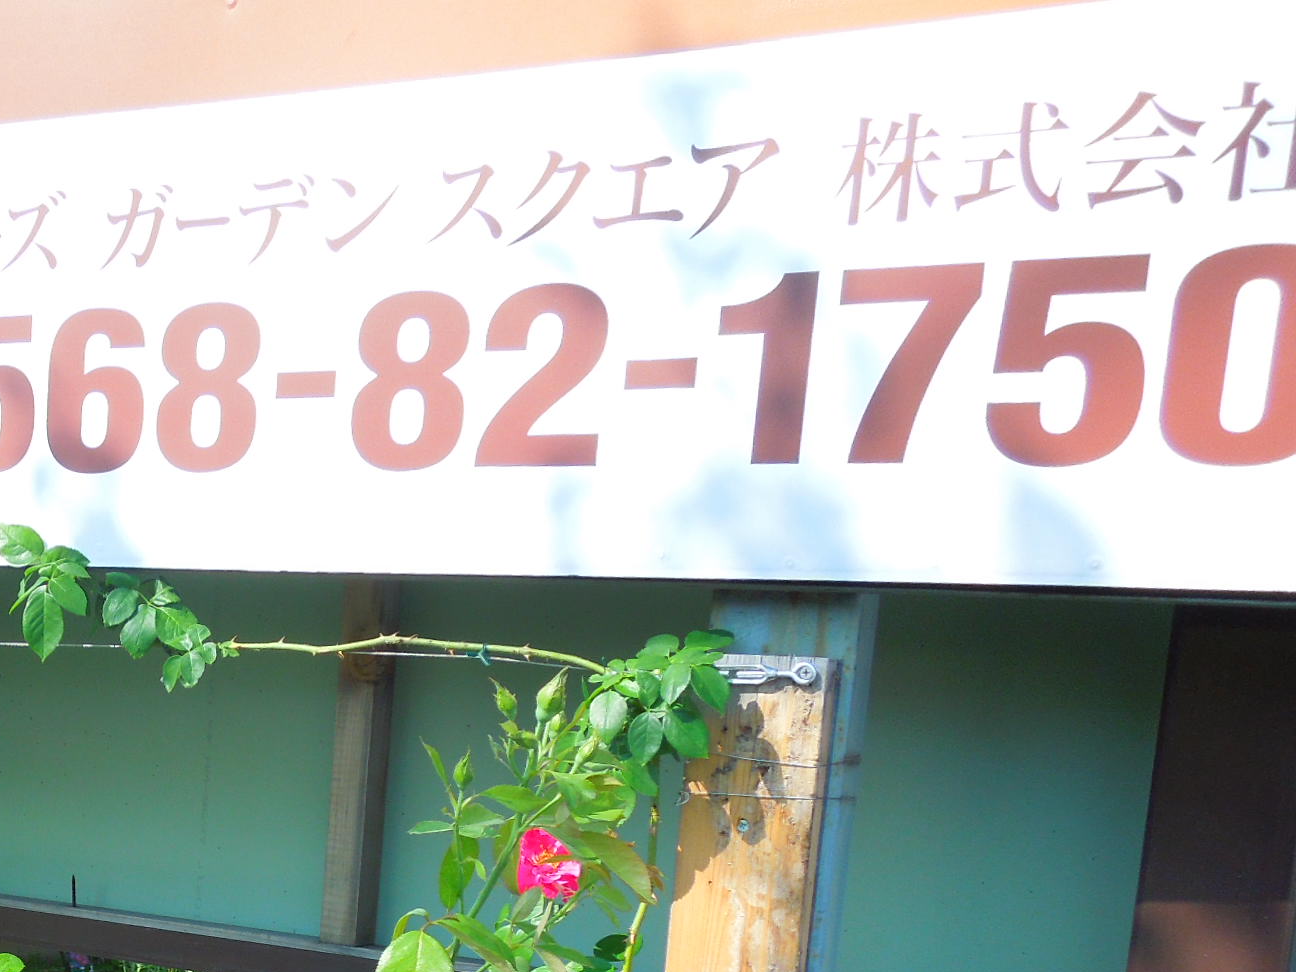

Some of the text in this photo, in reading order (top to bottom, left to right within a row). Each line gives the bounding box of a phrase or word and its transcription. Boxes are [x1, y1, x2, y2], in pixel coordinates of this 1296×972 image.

[100, 173, 399, 270] ガーデン
[427, 137, 780, 247] スクエア
[835, 81, 1296, 226] 株式会社
